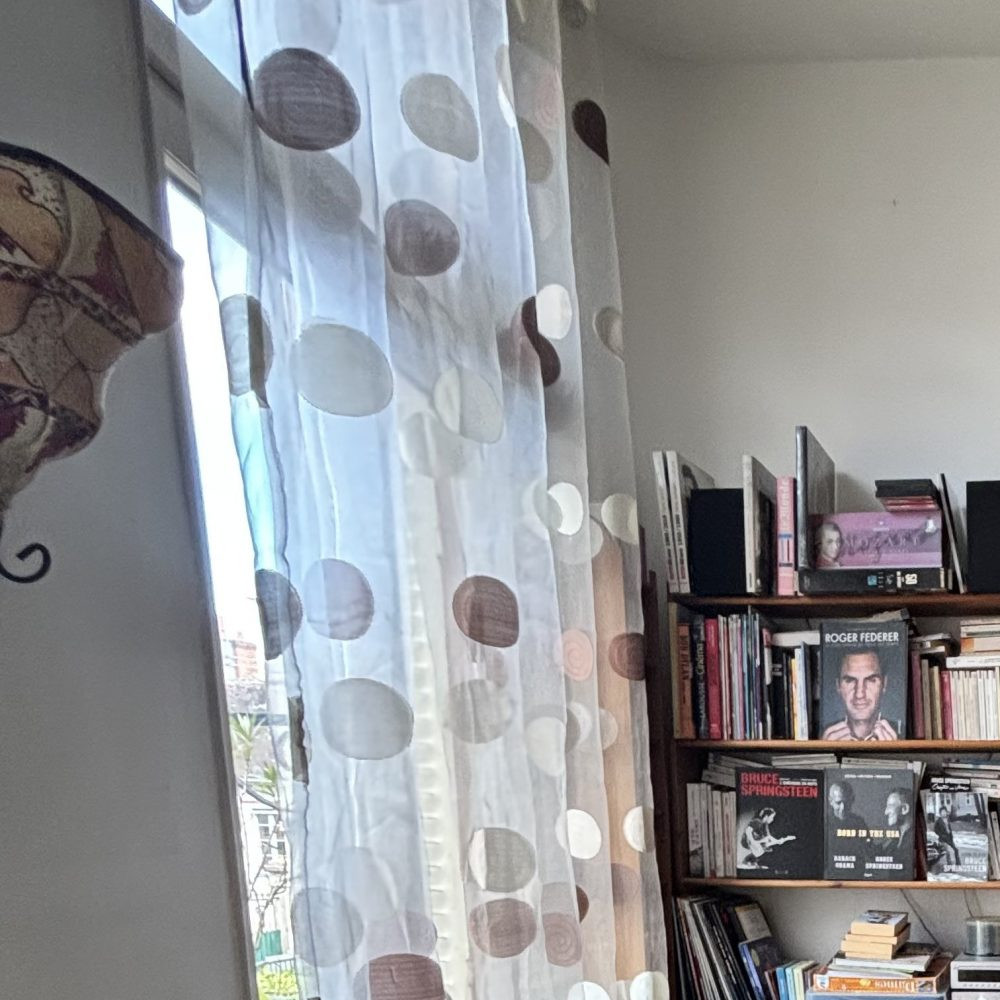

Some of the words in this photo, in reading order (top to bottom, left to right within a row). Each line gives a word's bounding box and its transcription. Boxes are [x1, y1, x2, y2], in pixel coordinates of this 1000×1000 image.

[825, 632, 858, 643] ROGER
[860, 632, 899, 642] FEDERER
[741, 772, 779, 784] BRUCE
[741, 784, 818, 797] SPRINGSTEEN
[837, 829, 856, 837] BORN
[858, 829, 867, 837] IN
[869, 829, 884, 838] THE
[886, 830, 900, 838] USA
[943, 864, 987, 873] SPRINGSTEEN
